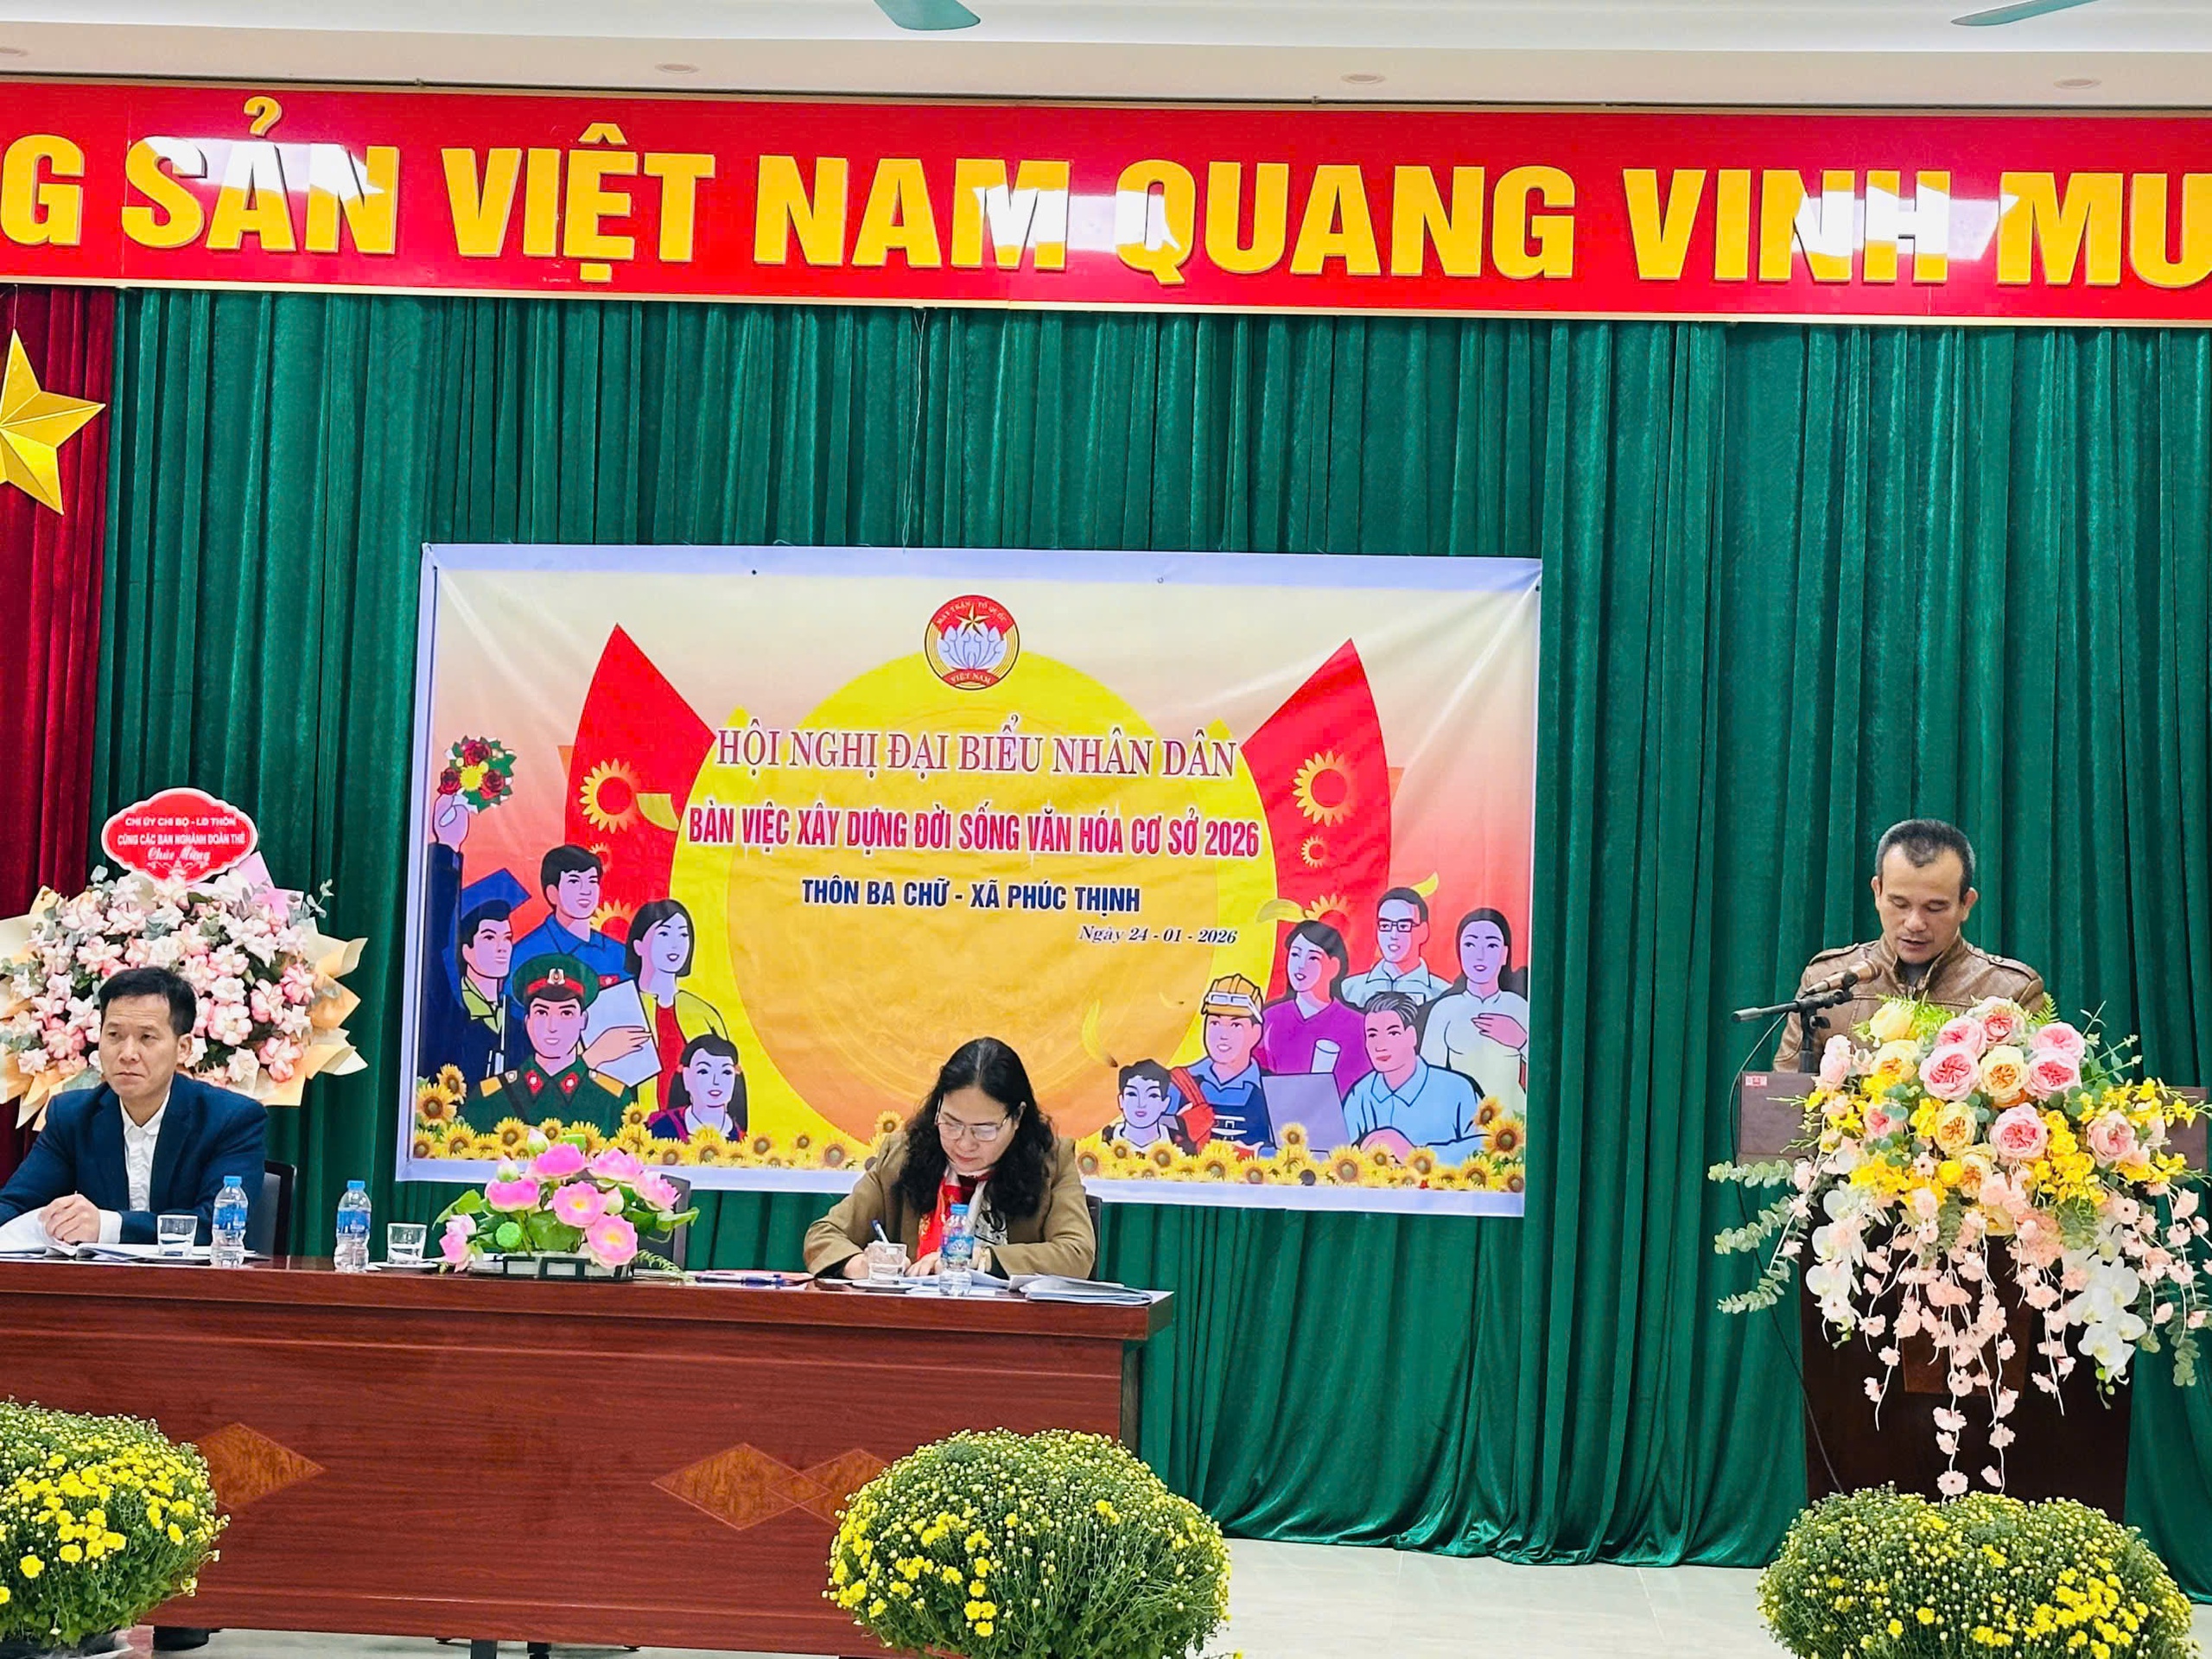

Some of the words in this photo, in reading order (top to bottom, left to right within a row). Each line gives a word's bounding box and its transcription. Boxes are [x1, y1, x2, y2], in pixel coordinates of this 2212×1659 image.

[0, 134, 85, 247] G
[121, 95, 400, 257] SẢN
[442, 123, 716, 283] VIỆT
[753, 155, 1071, 271] NAM
[1115, 159, 1577, 285] QUANG
[1622, 168, 1952, 285] VINH
[1996, 170, 2212, 289] MU
[972, 672, 991, 684] NAM
[716, 718, 780, 776] HỘI
[789, 731, 880, 779] NGHỊ
[887, 734, 950, 779] ĐẠI
[958, 715, 1043, 772] BIỂU
[1052, 727, 1154, 775] NHÂN
[1163, 728, 1236, 778] DÂN
[125, 817, 142, 826] CHI
[157, 817, 174, 827] CHI
[689, 800, 734, 843] BÀN
[742, 801, 790, 853] VIỆC
[797, 802, 841, 846] XÂY
[847, 807, 908, 855] DỰNG
[914, 804, 951, 849] ĐỜI
[958, 802, 1020, 851] SỐNG
[1027, 807, 1071, 853] VĂN
[1079, 810, 1123, 854] HÓA
[1131, 815, 1163, 855] CƠ
[1168, 807, 1200, 856] SỞ
[1205, 821, 1259, 857] 2026
[139, 832, 156, 845] CÁC
[157, 834, 174, 845] BAN
[802, 874, 861, 905] THÔN
[867, 879, 895, 905] BA
[903, 877, 950, 907] CHỮ
[970, 880, 1000, 908] XÃ
[1007, 880, 1067, 911] PHÚC
[1074, 887, 1141, 917] THỊNH
[1078, 925, 1125, 944] Ngày
[1128, 927, 1148, 942] 24
[1163, 929, 1181, 943] 01
[1198, 929, 1237, 944] 2026
